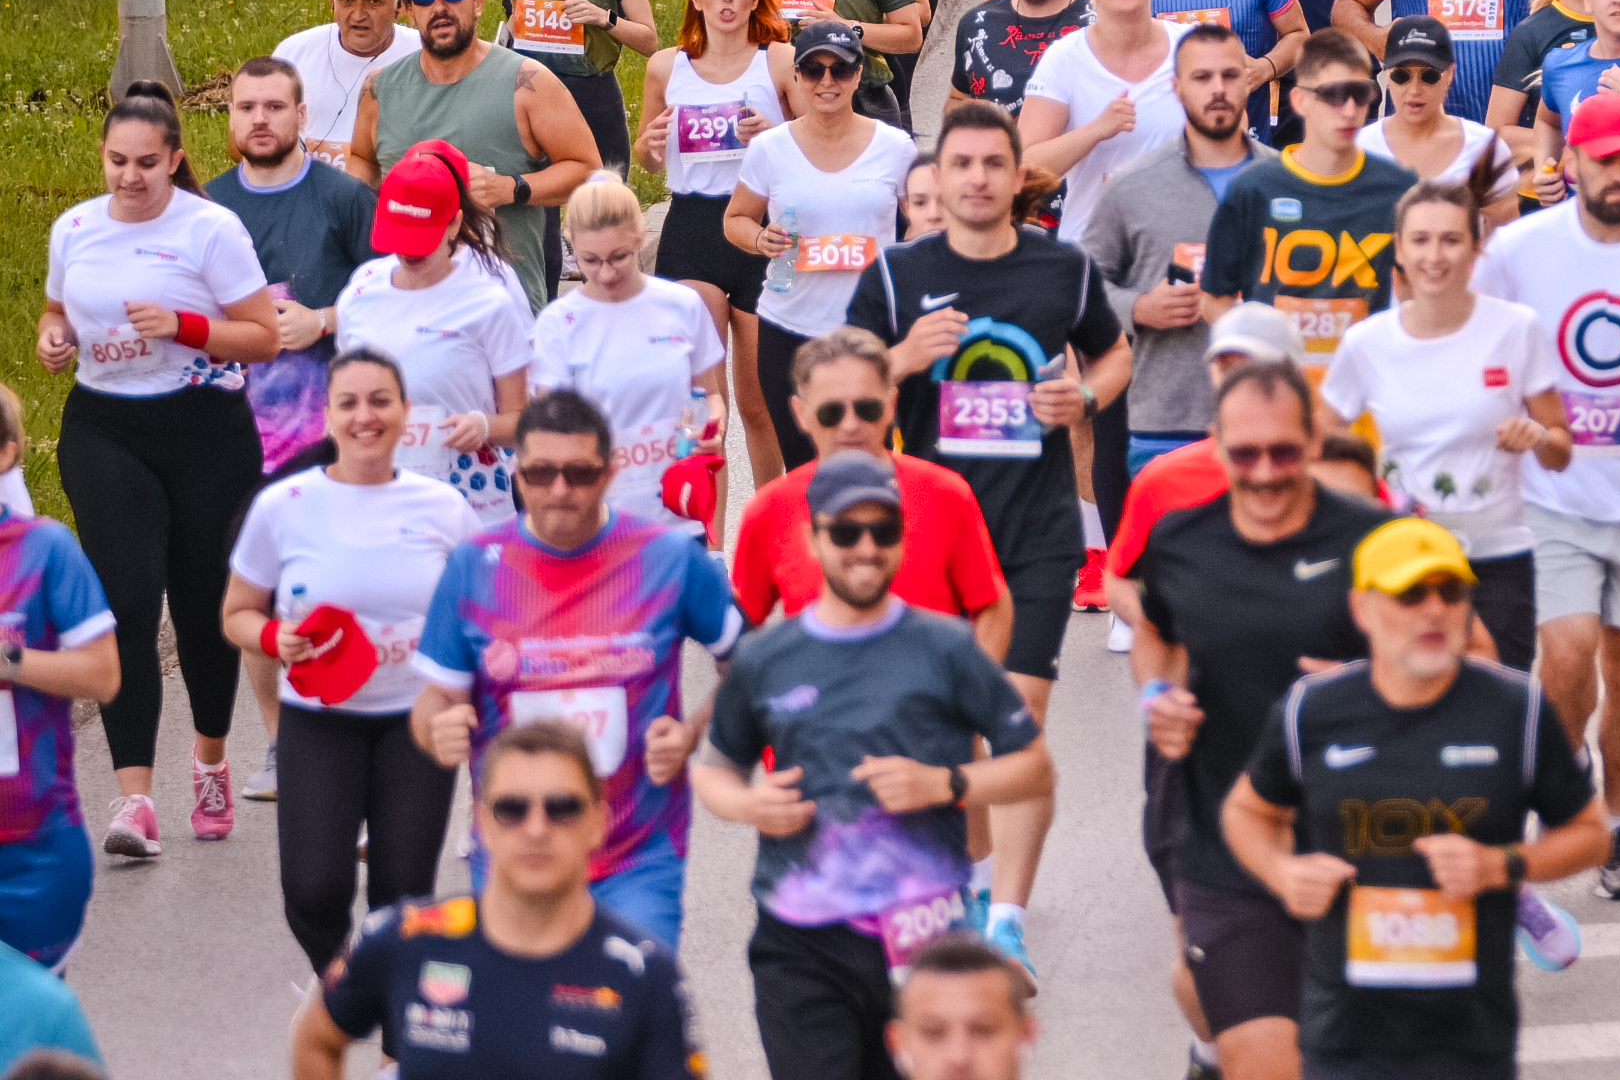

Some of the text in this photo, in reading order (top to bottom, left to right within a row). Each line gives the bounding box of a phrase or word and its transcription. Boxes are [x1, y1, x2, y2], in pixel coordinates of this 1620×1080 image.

[523, 8, 573, 31] 5146
[687, 116, 741, 140] 2391
[806, 246, 866, 266] 5015
[1263, 228, 1392, 289] 10K
[92, 340, 149, 363] 8052
[952, 399, 1027, 427] 2353
[893, 888, 971, 948] 2004
